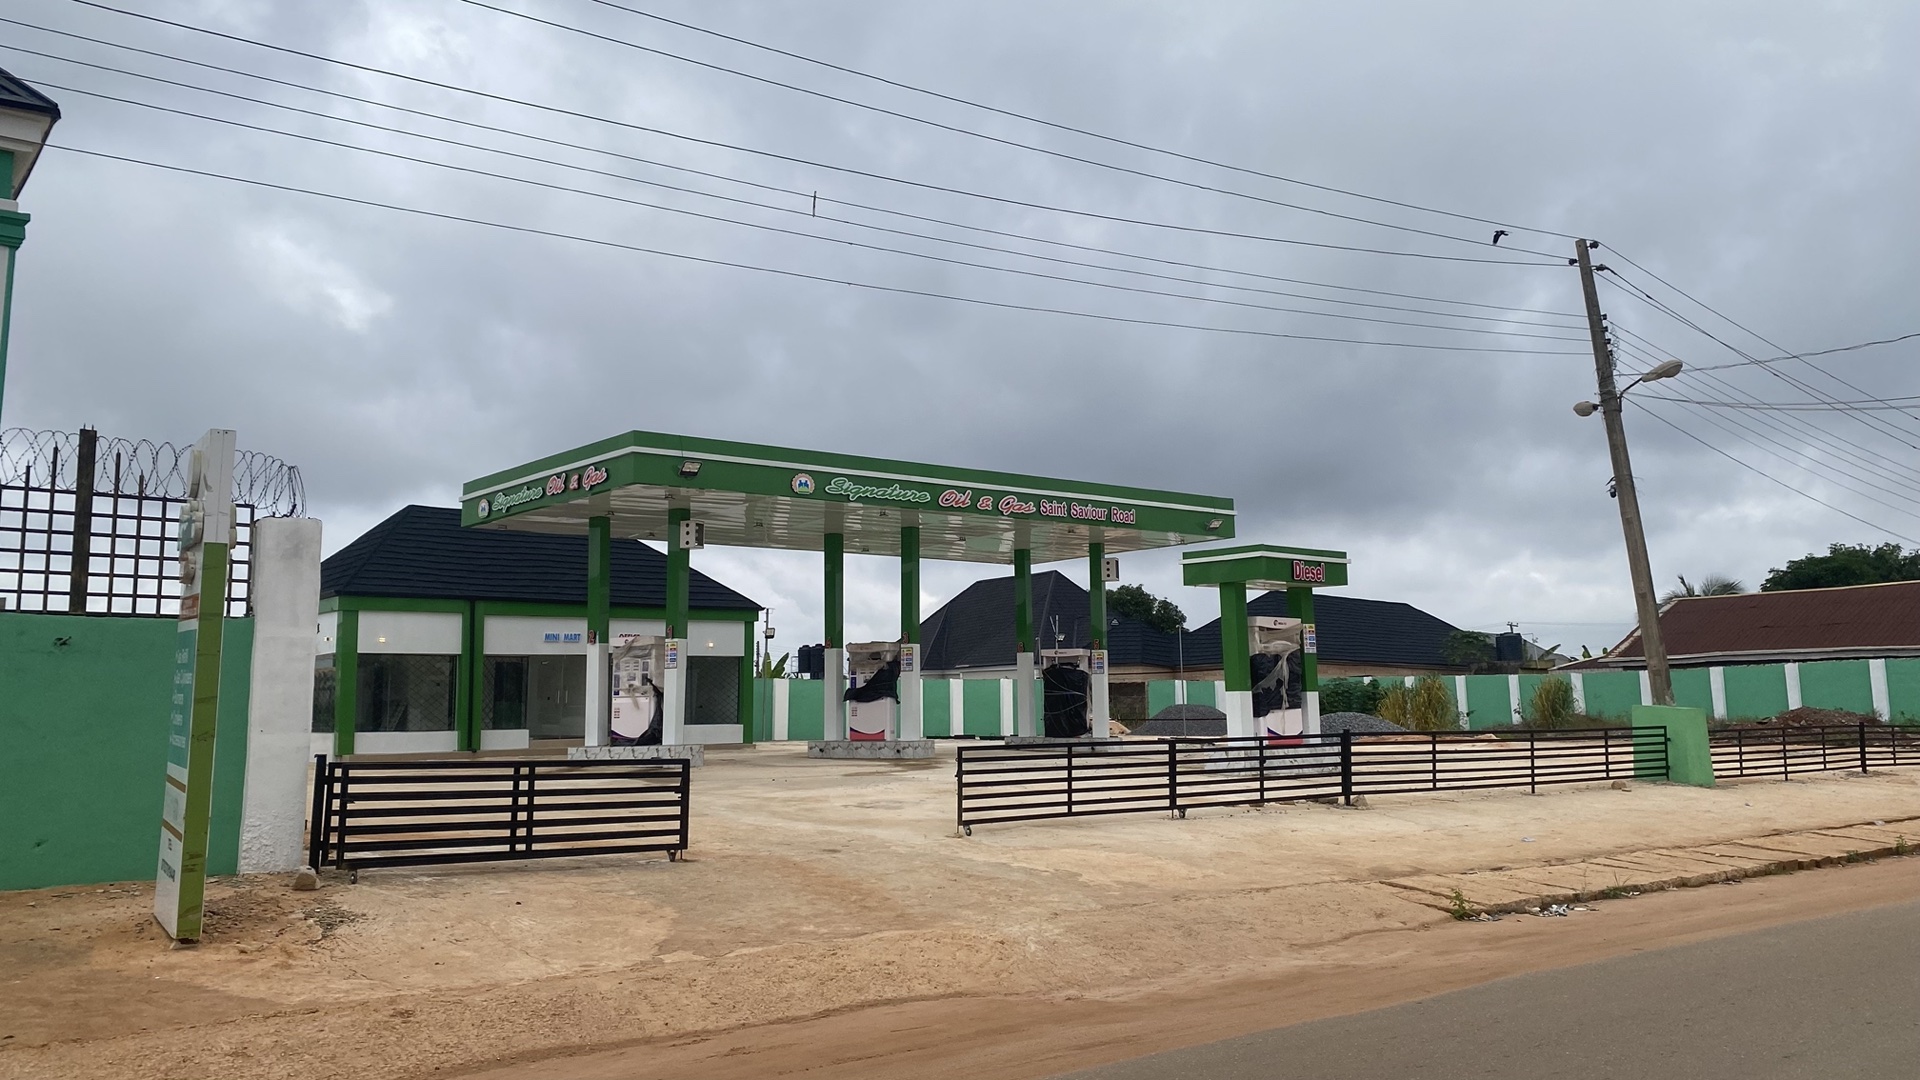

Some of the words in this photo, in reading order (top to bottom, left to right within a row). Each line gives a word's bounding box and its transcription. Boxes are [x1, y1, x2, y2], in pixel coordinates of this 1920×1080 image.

[492, 485, 544, 513] Signature
[546, 472, 567, 496] Oil
[568, 473, 579, 490] &
[582, 465, 608, 491] Gas
[825, 477, 931, 503] Signature
[938, 489, 972, 508] Oil
[977, 496, 993, 511] &
[998, 495, 1037, 515] Gas
[1040, 499, 1067, 517] Saint
[1070, 502, 1107, 521] Saviour
[1111, 506, 1136, 524] Road
[1293, 560, 1326, 582] Diesel
[544, 632, 560, 643] MINI
[563, 632, 582, 643] MART
